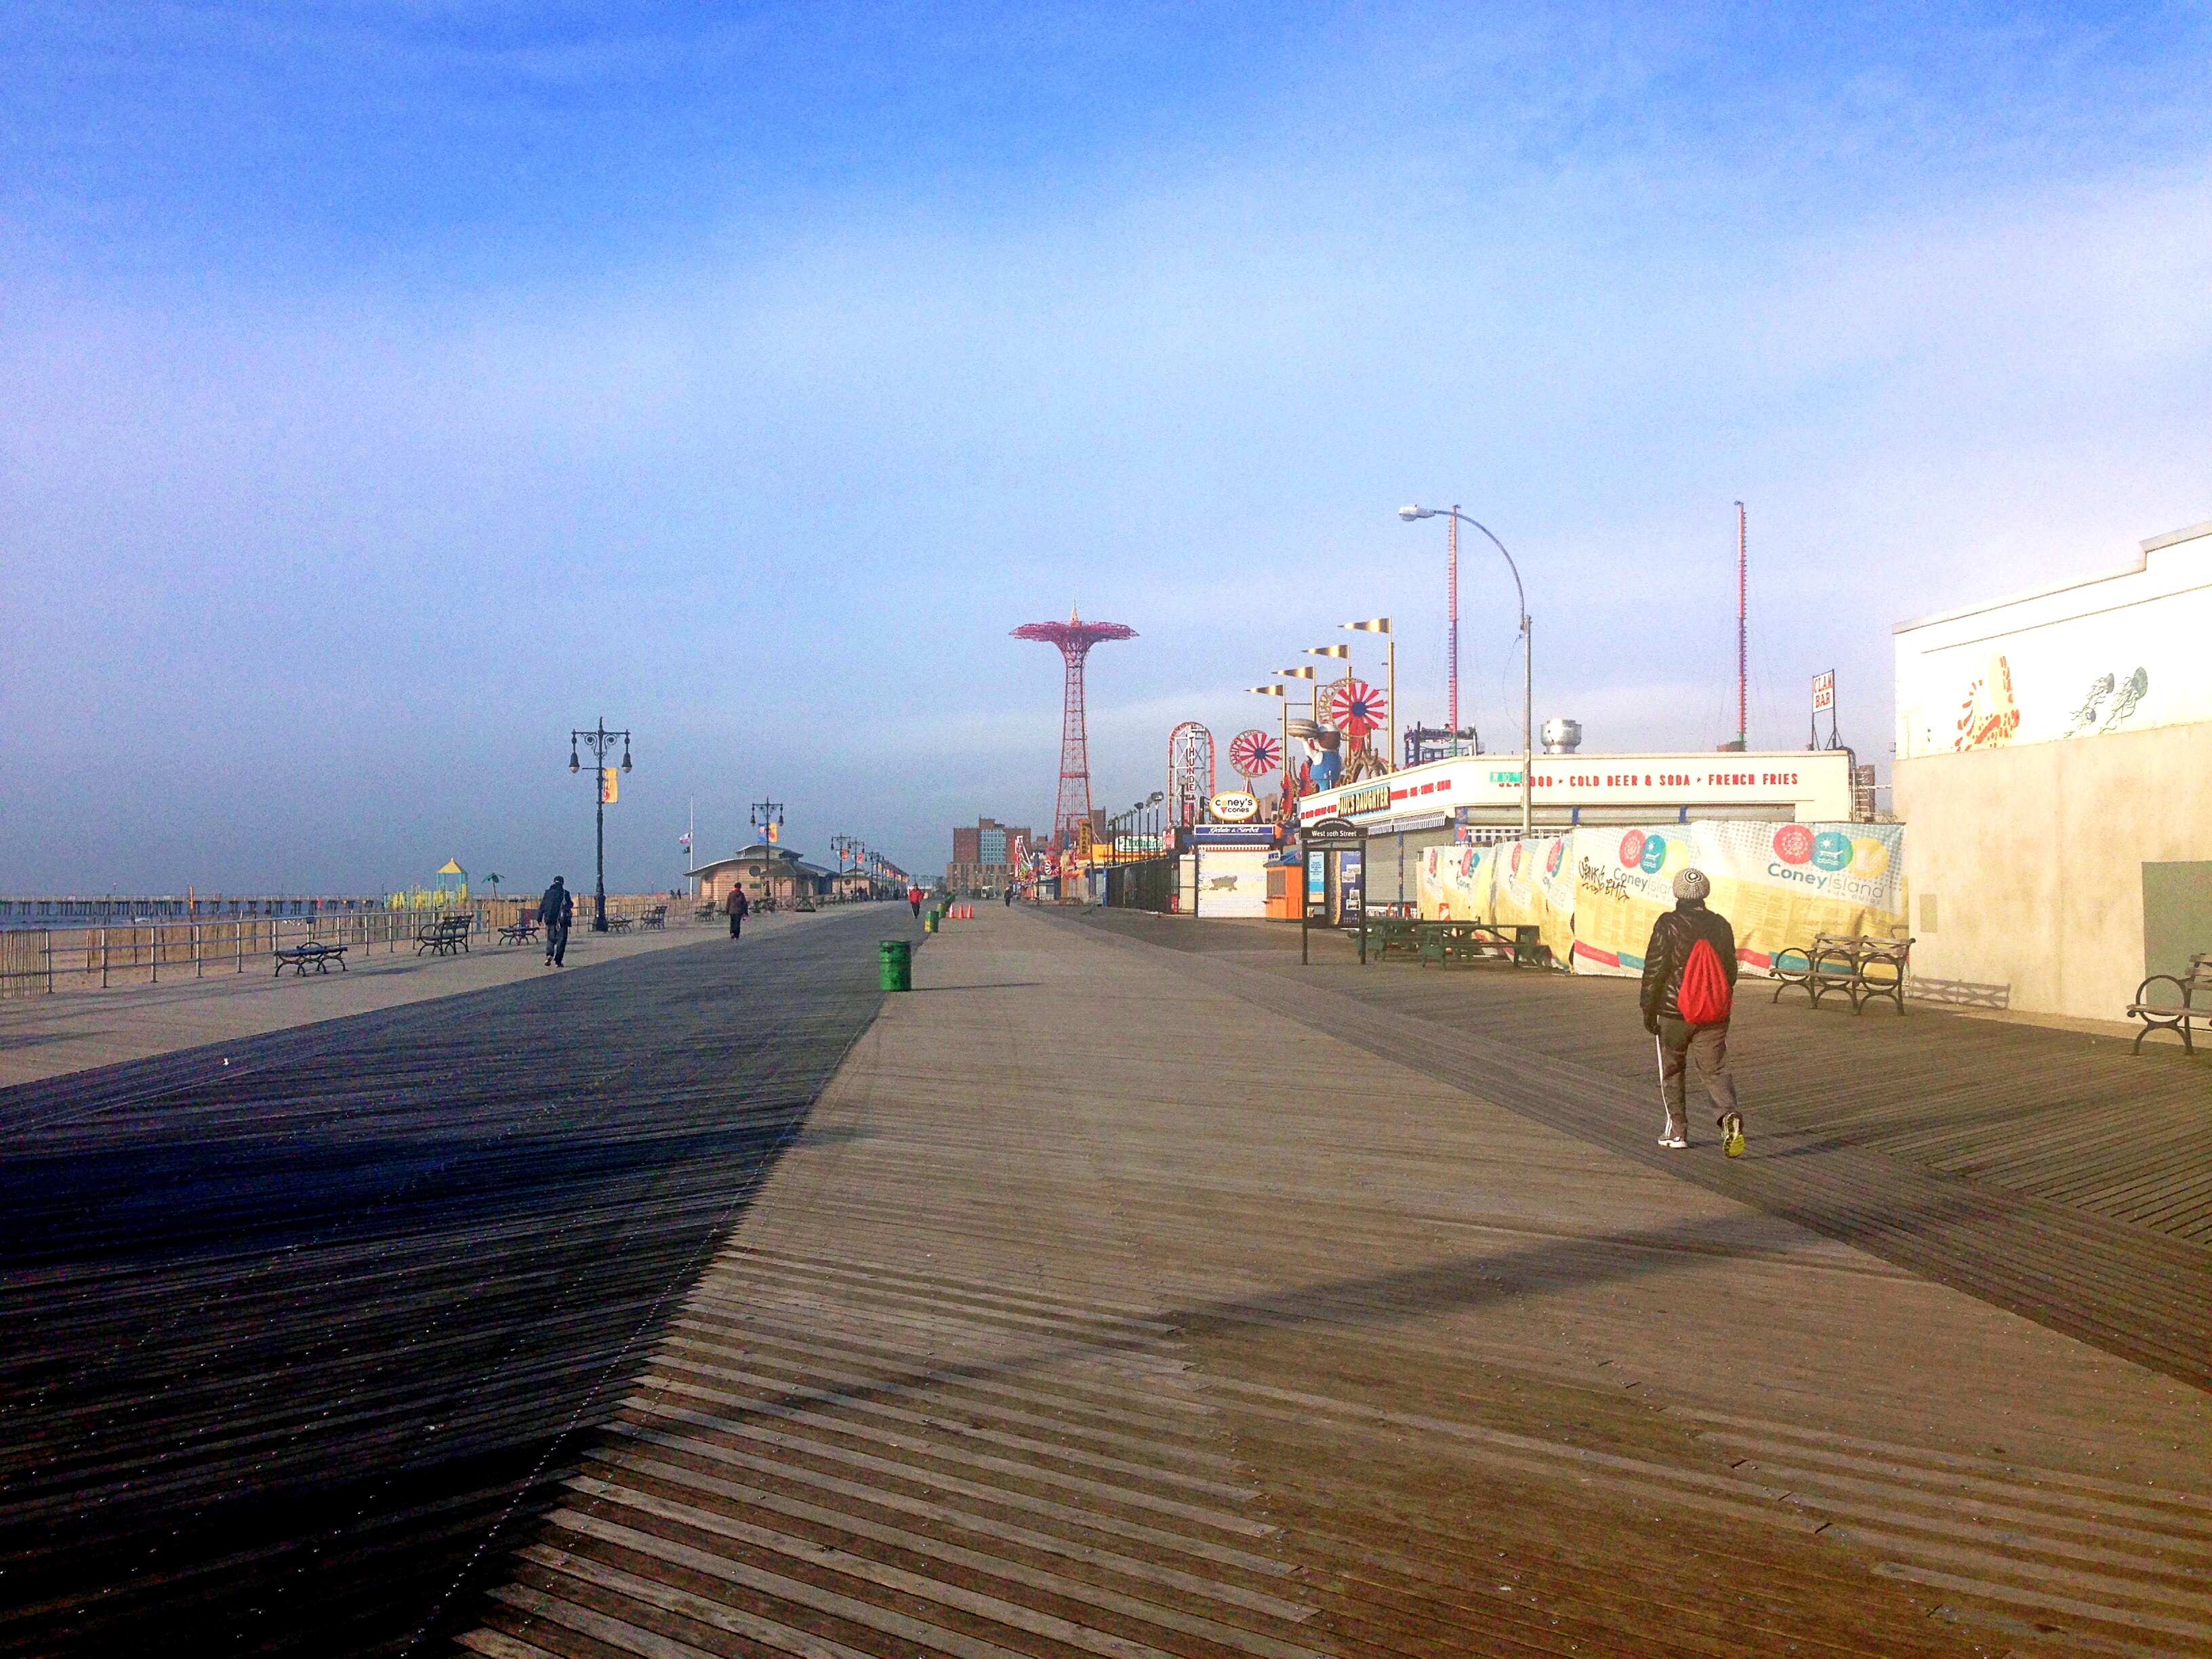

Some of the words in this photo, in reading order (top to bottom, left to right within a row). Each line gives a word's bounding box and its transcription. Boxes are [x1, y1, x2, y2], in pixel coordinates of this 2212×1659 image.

[1814, 674, 1832, 693] CLAM
[1816, 692, 1830, 708] BAR
[1570, 775, 1599, 787] COLD
[1607, 775, 1637, 786] BEER
[1645, 775, 1652, 786] &
[1660, 774, 1690, 785] SODA
[1708, 774, 1755, 785] FRENCH
[1763, 773, 1798, 785] FRIES
[1215, 798, 1253, 808] coney's
[1355, 786, 1389, 812] DAUGHTER
[1614, 867, 1648, 892] Coney
[1647, 876, 1675, 895] Islan
[1767, 863, 1828, 889] Coney
[1828, 874, 1886, 898] Island
